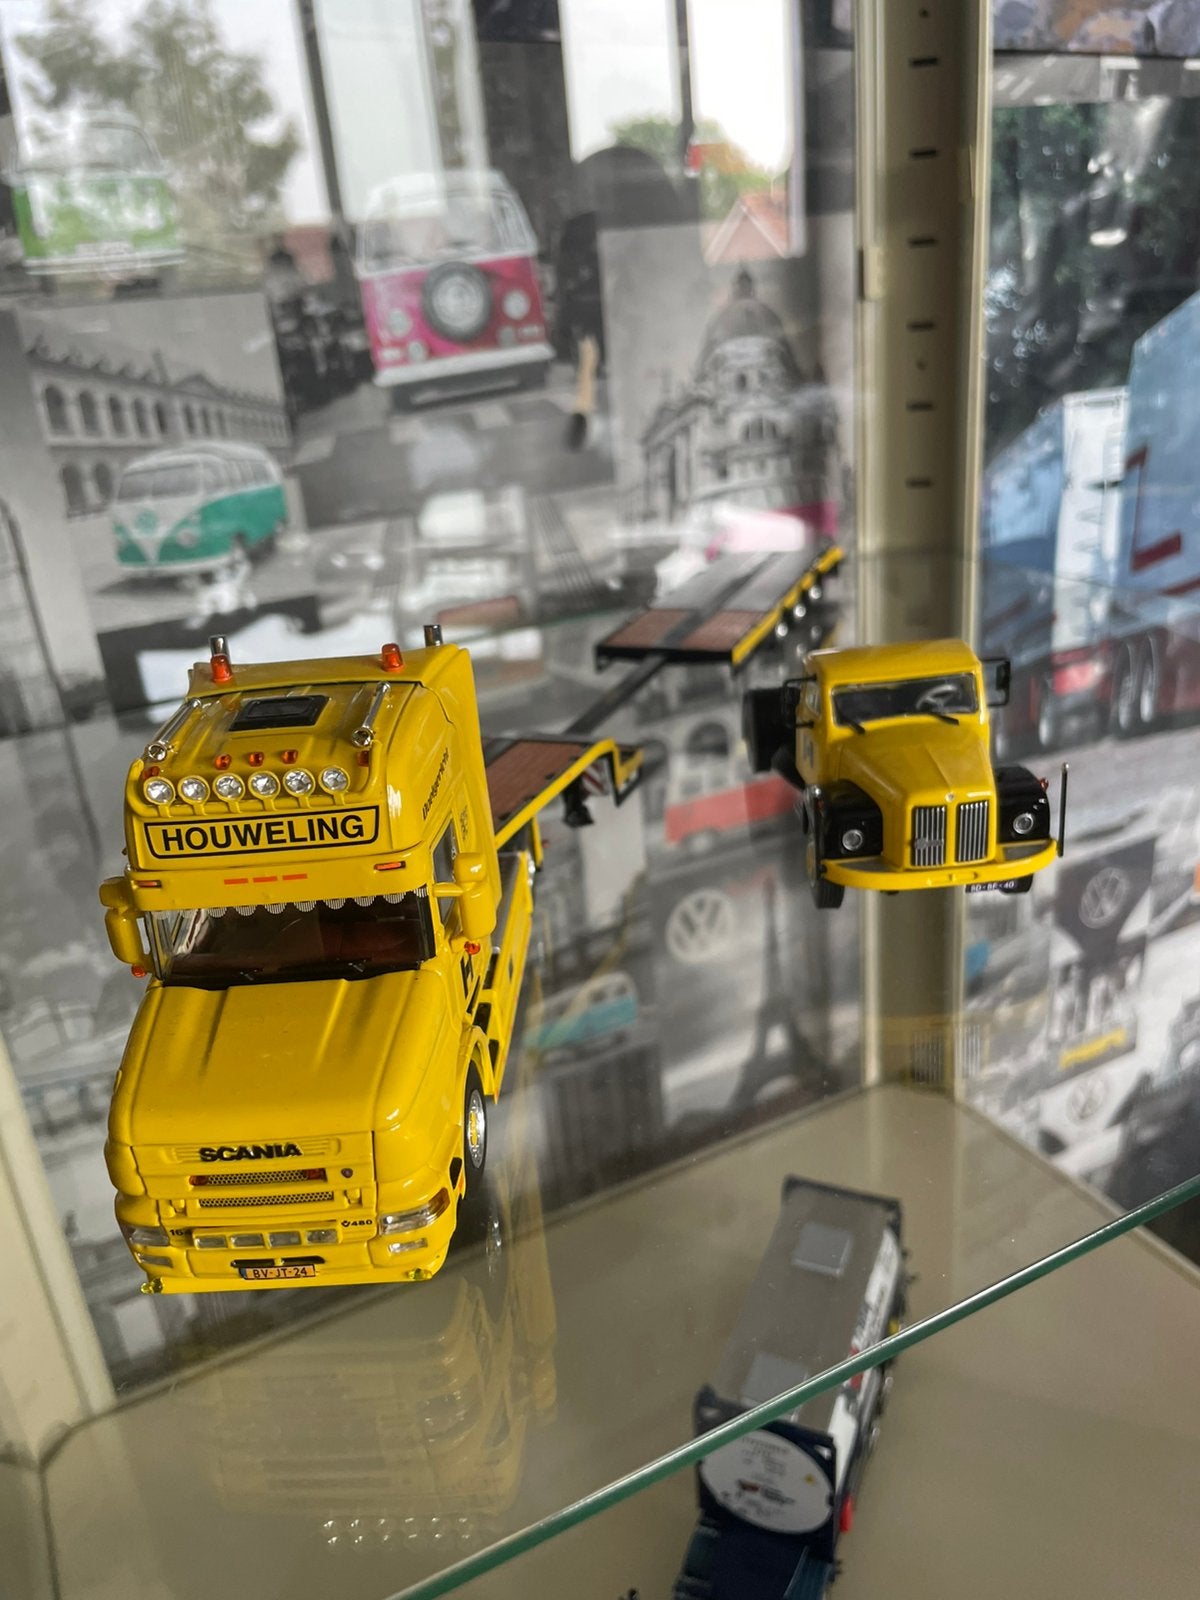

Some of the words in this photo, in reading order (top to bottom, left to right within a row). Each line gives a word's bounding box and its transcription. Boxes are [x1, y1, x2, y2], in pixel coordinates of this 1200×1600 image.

[162, 814, 364, 852] HOUWELING
[199, 1142, 303, 1163] SCANIA
[252, 1267, 308, 1279] BV-JT-24
